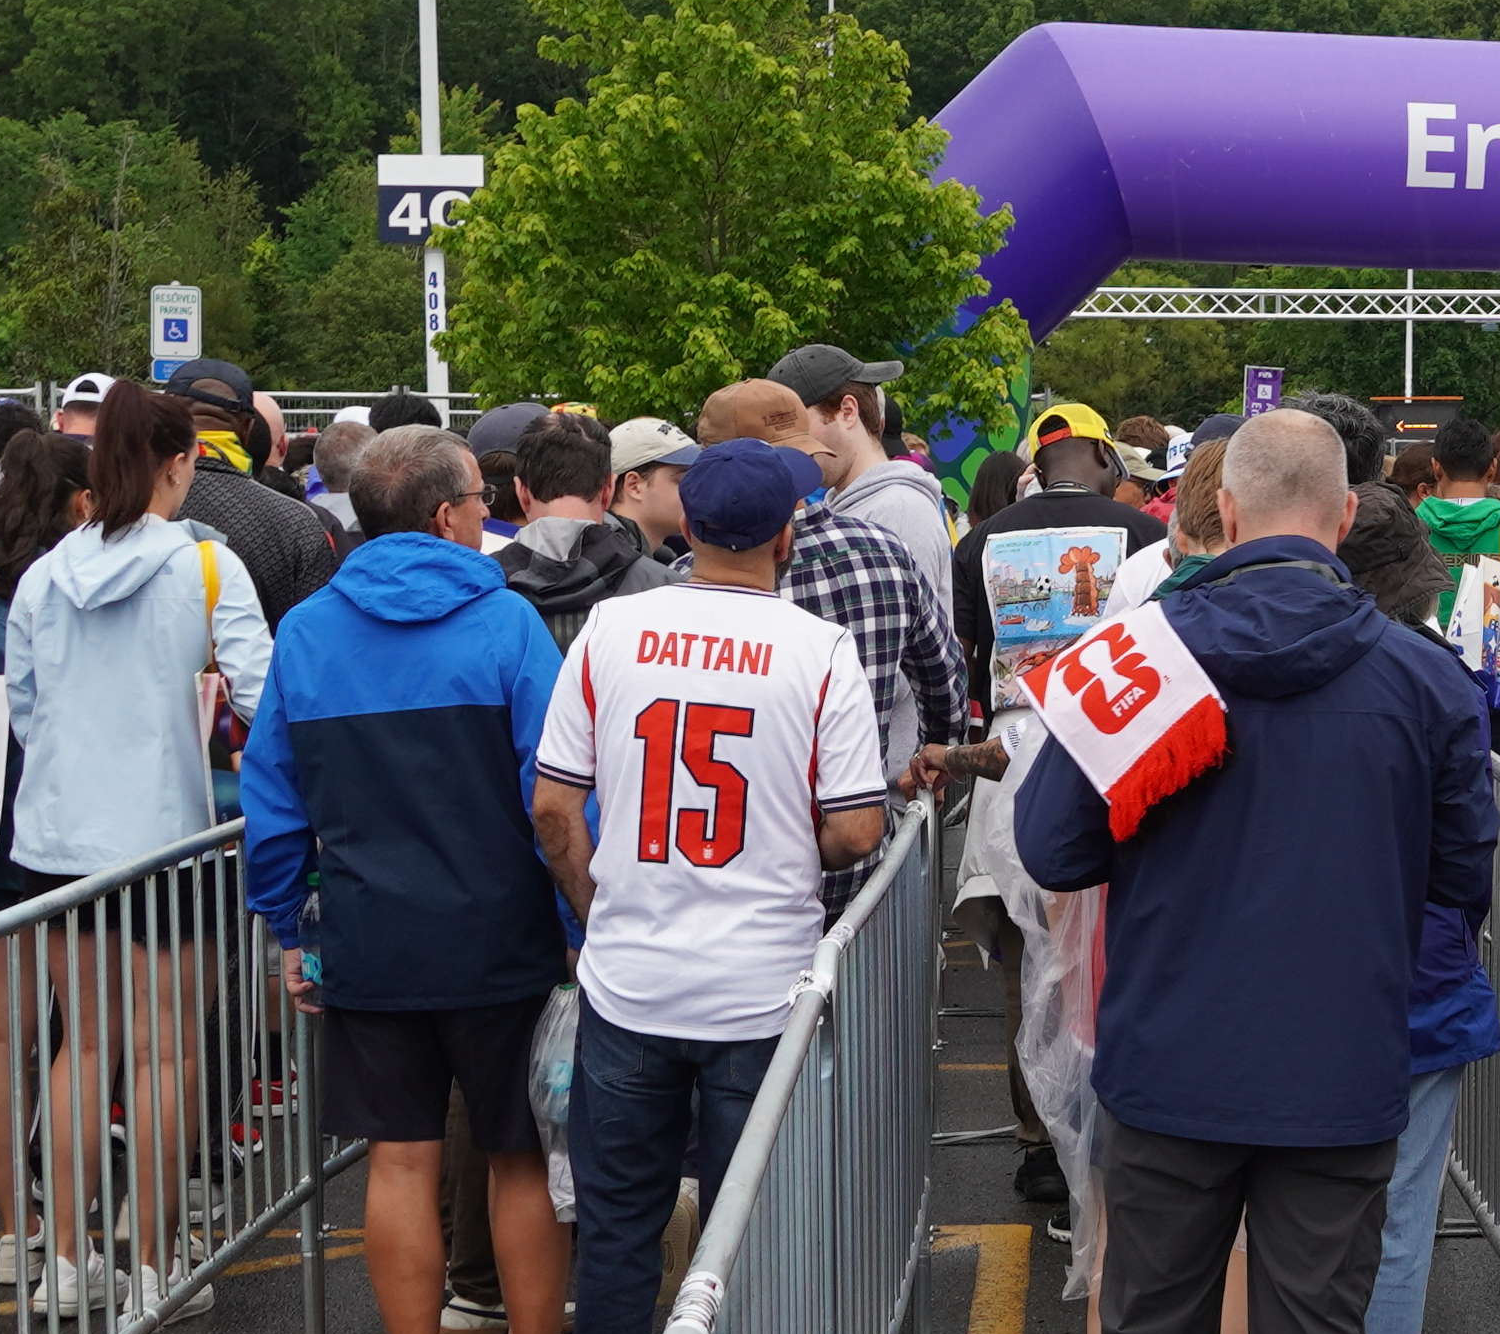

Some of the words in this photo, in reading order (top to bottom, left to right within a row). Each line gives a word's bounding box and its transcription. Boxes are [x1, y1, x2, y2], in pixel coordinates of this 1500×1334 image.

[155, 293, 197, 304] RESERVED
[159, 306, 193, 316] PARKING
[428, 271, 439, 331] 408
[637, 630, 773, 676] DATTANI
[1111, 686, 1147, 718] FIFA
[634, 697, 755, 868] 15
